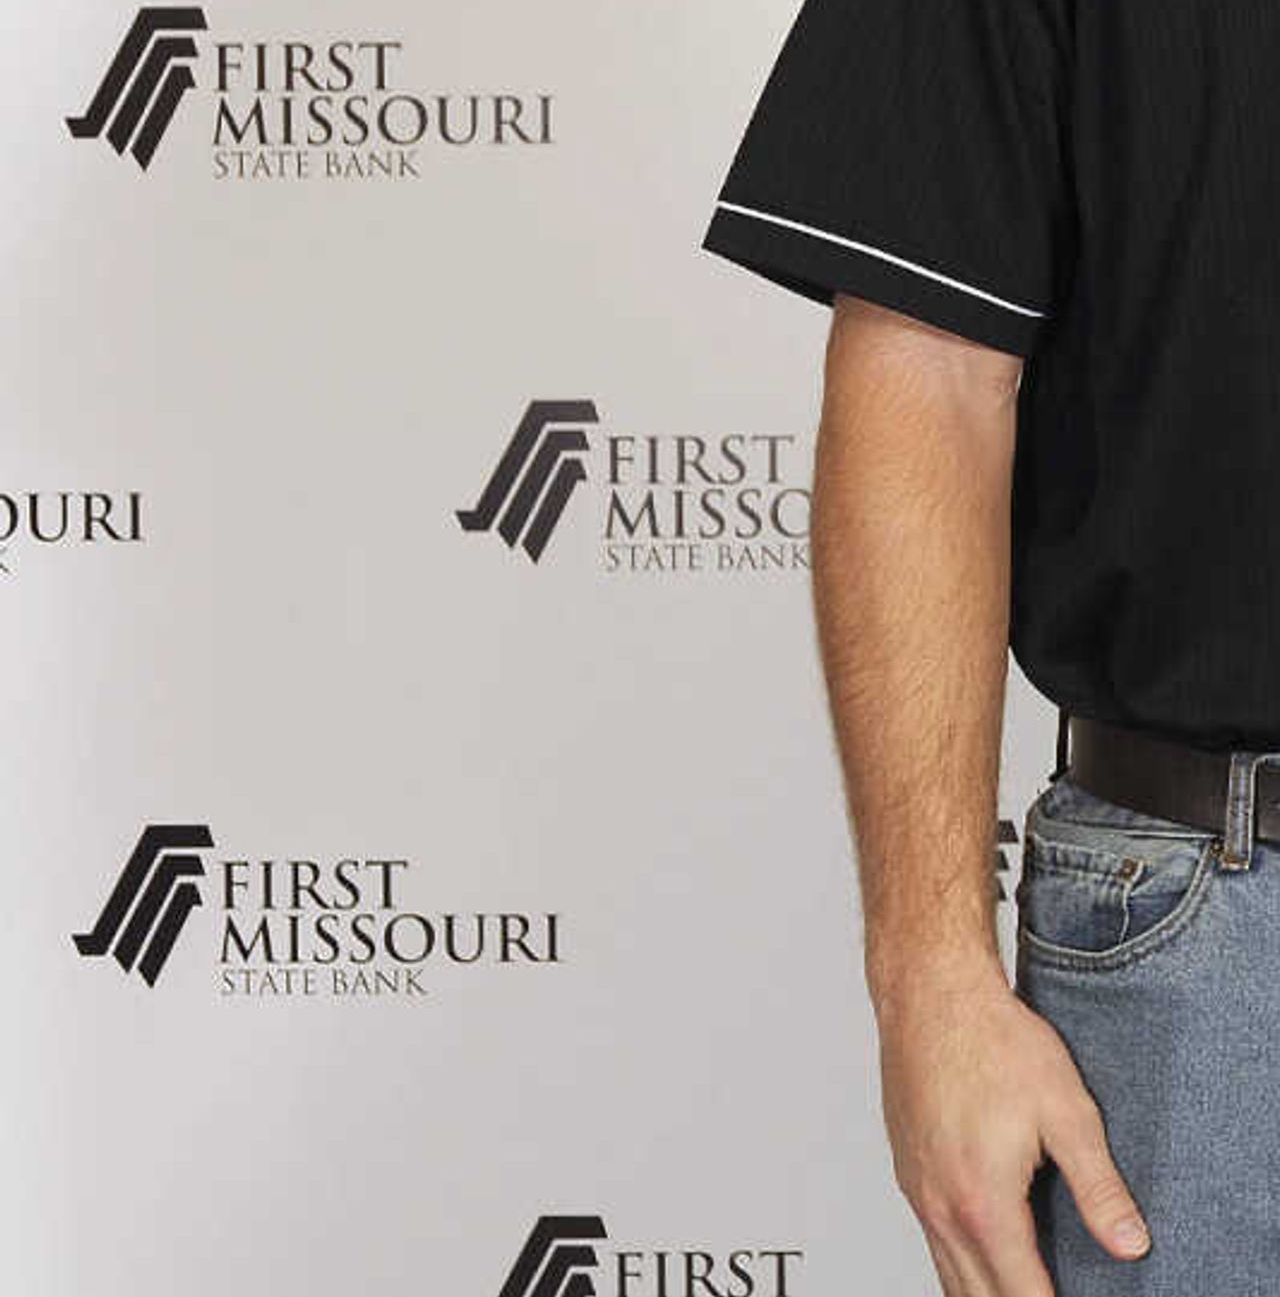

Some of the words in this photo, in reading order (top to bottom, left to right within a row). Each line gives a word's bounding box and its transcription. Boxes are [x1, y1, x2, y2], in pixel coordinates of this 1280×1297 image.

[214, 41, 402, 93] FIRST
[211, 94, 552, 146] MISSOURI
[212, 150, 310, 177] STATE
[324, 150, 420, 177] BANK
[606, 434, 794, 486] FIRST
[604, 487, 811, 540] MISSO
[604, 543, 702, 570] STATE
[717, 543, 811, 570] BANK
[221, 858, 409, 910] FIRST
[218, 911, 559, 963] MISSOURI
[219, 967, 317, 994] STATE
[331, 967, 427, 994] BANK
[616, 1249, 804, 1297] FIRST
